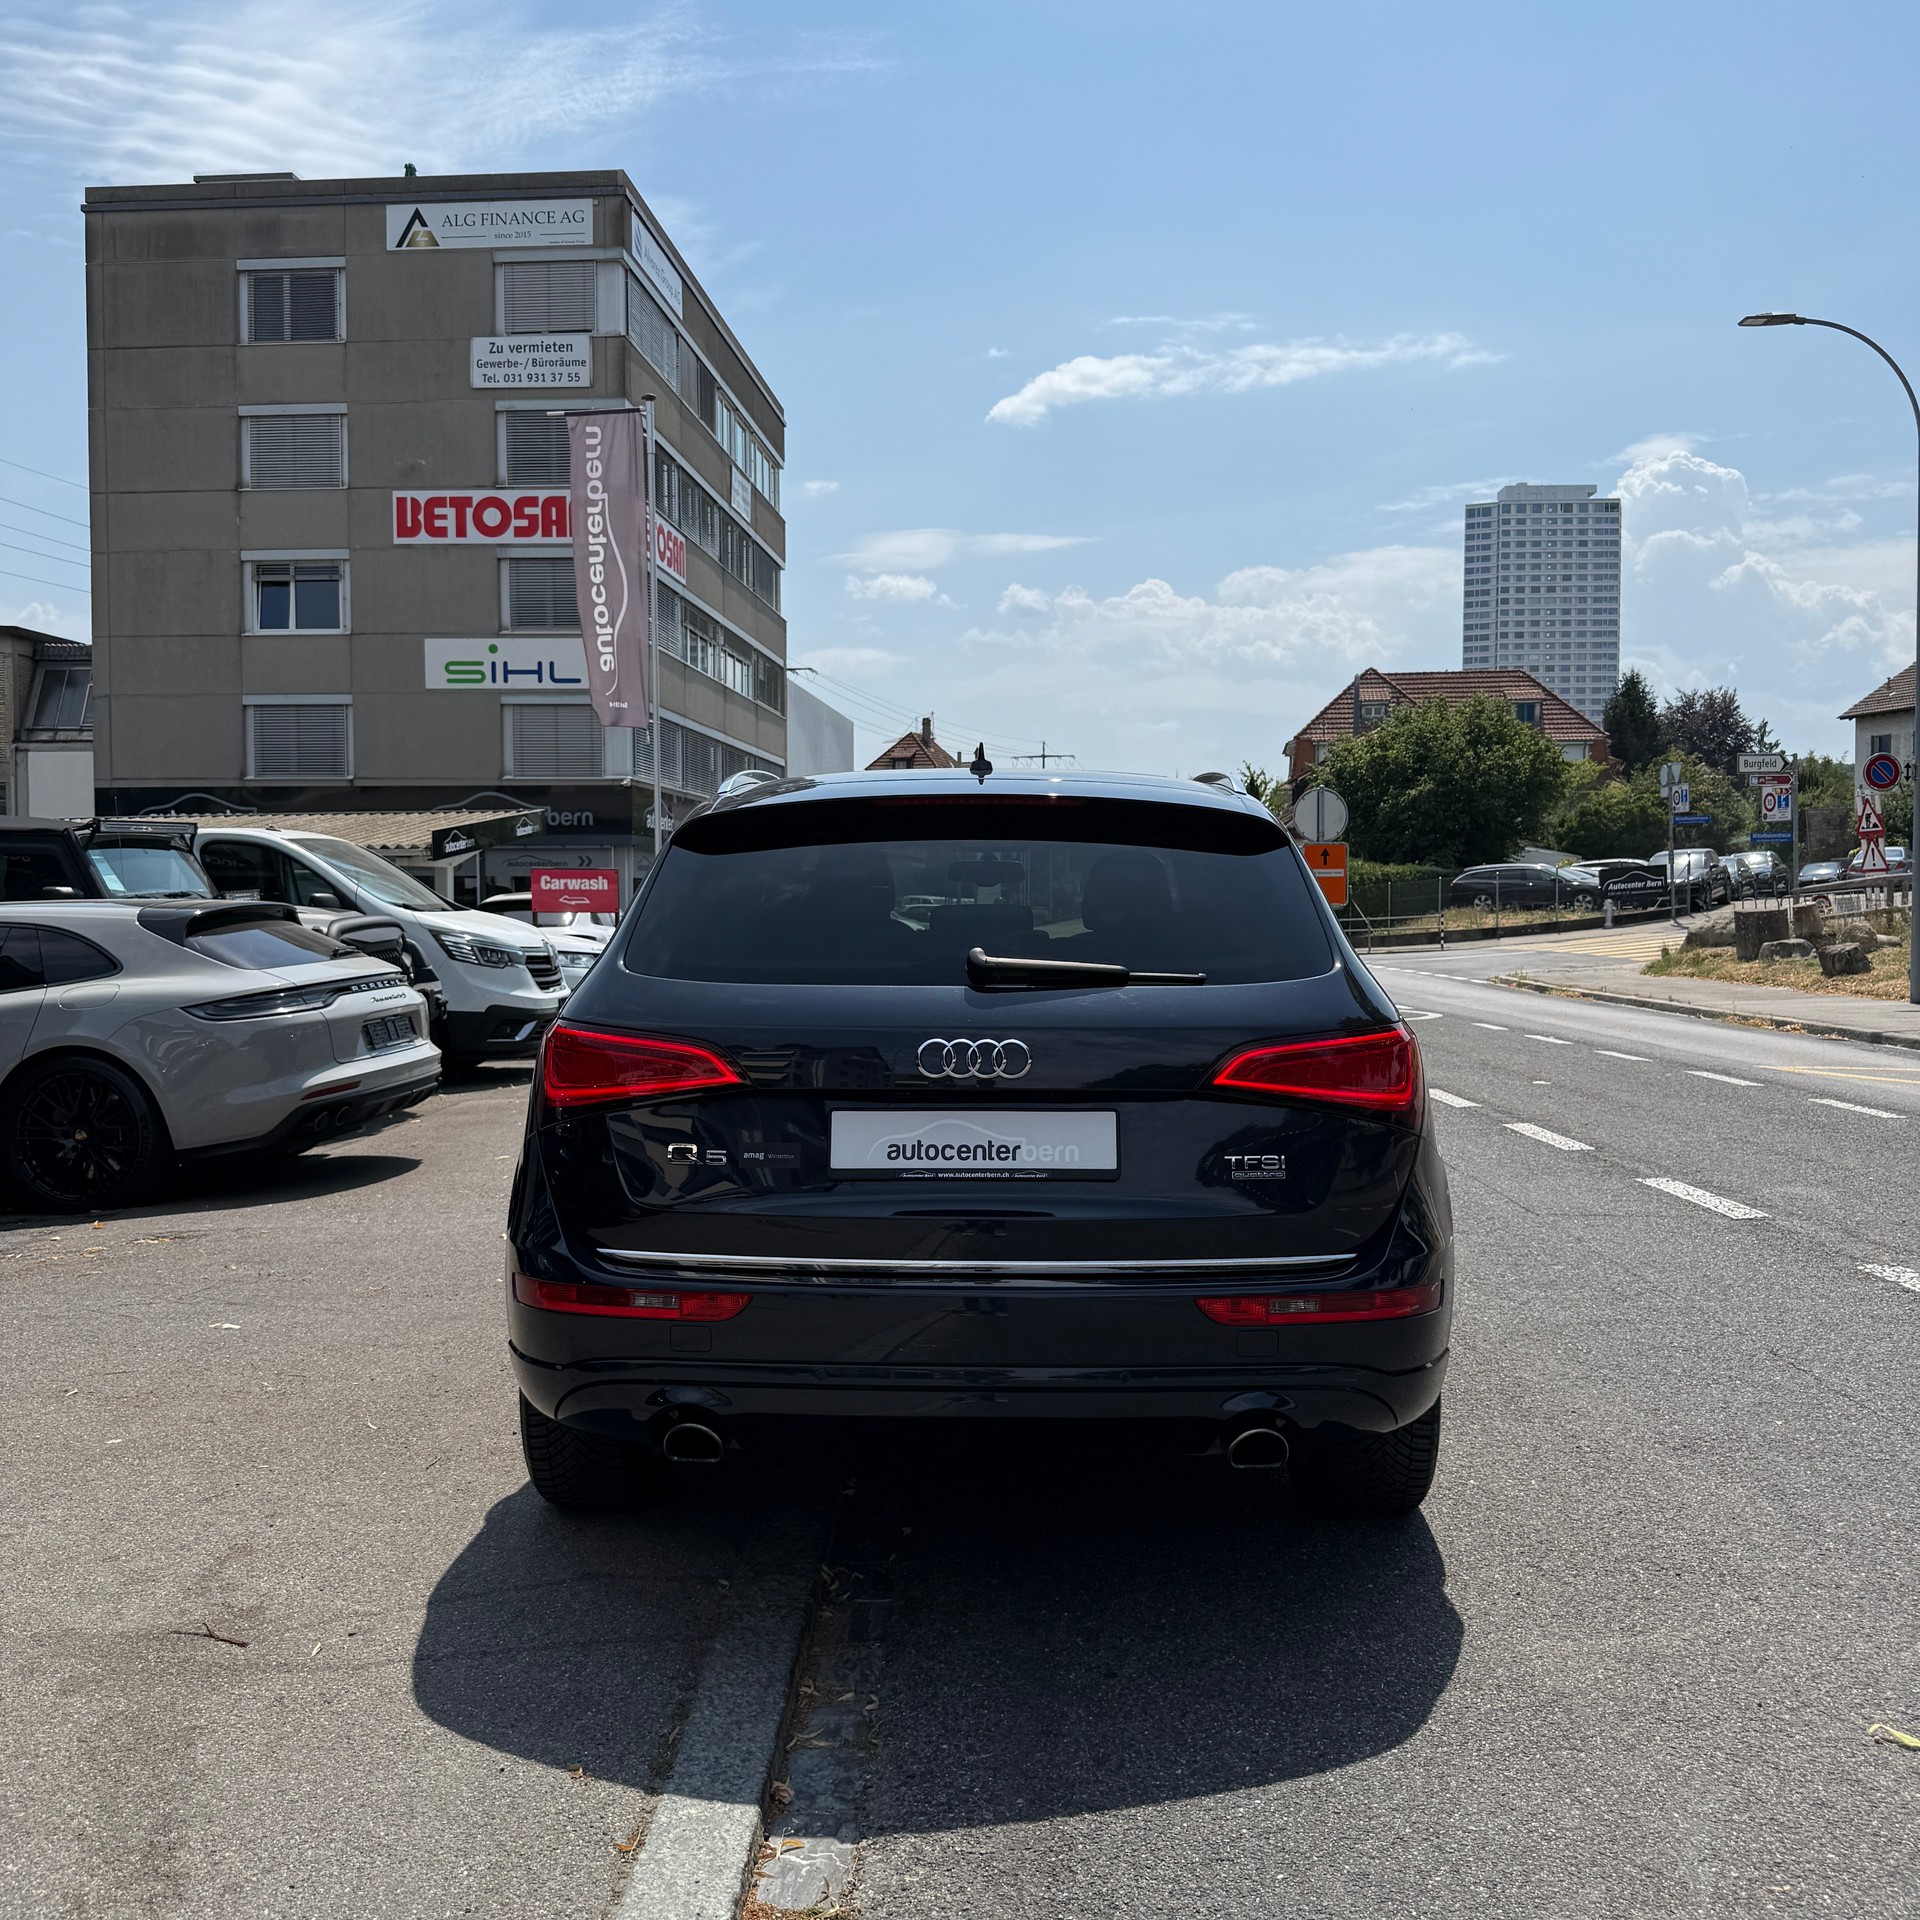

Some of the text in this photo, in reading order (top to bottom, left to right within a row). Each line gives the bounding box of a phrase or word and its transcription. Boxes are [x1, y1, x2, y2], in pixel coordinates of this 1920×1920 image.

[441, 209, 585, 227] ALG FINANCE AG
[494, 230, 532, 239] since 2015
[489, 341, 573, 354] Zu vermieten
[482, 372, 581, 383] Tel. 031 931 37 55
[396, 496, 573, 538] BETOSA
[1743, 759, 1777, 770] Burgfeld
[541, 875, 608, 891] Carwash
[1608, 880, 1662, 890] Autocenter Bern
[743, 1152, 764, 1161] amag
[887, 1140, 1079, 1161] autocenterbern
[1224, 1155, 1286, 1169] TFSI
